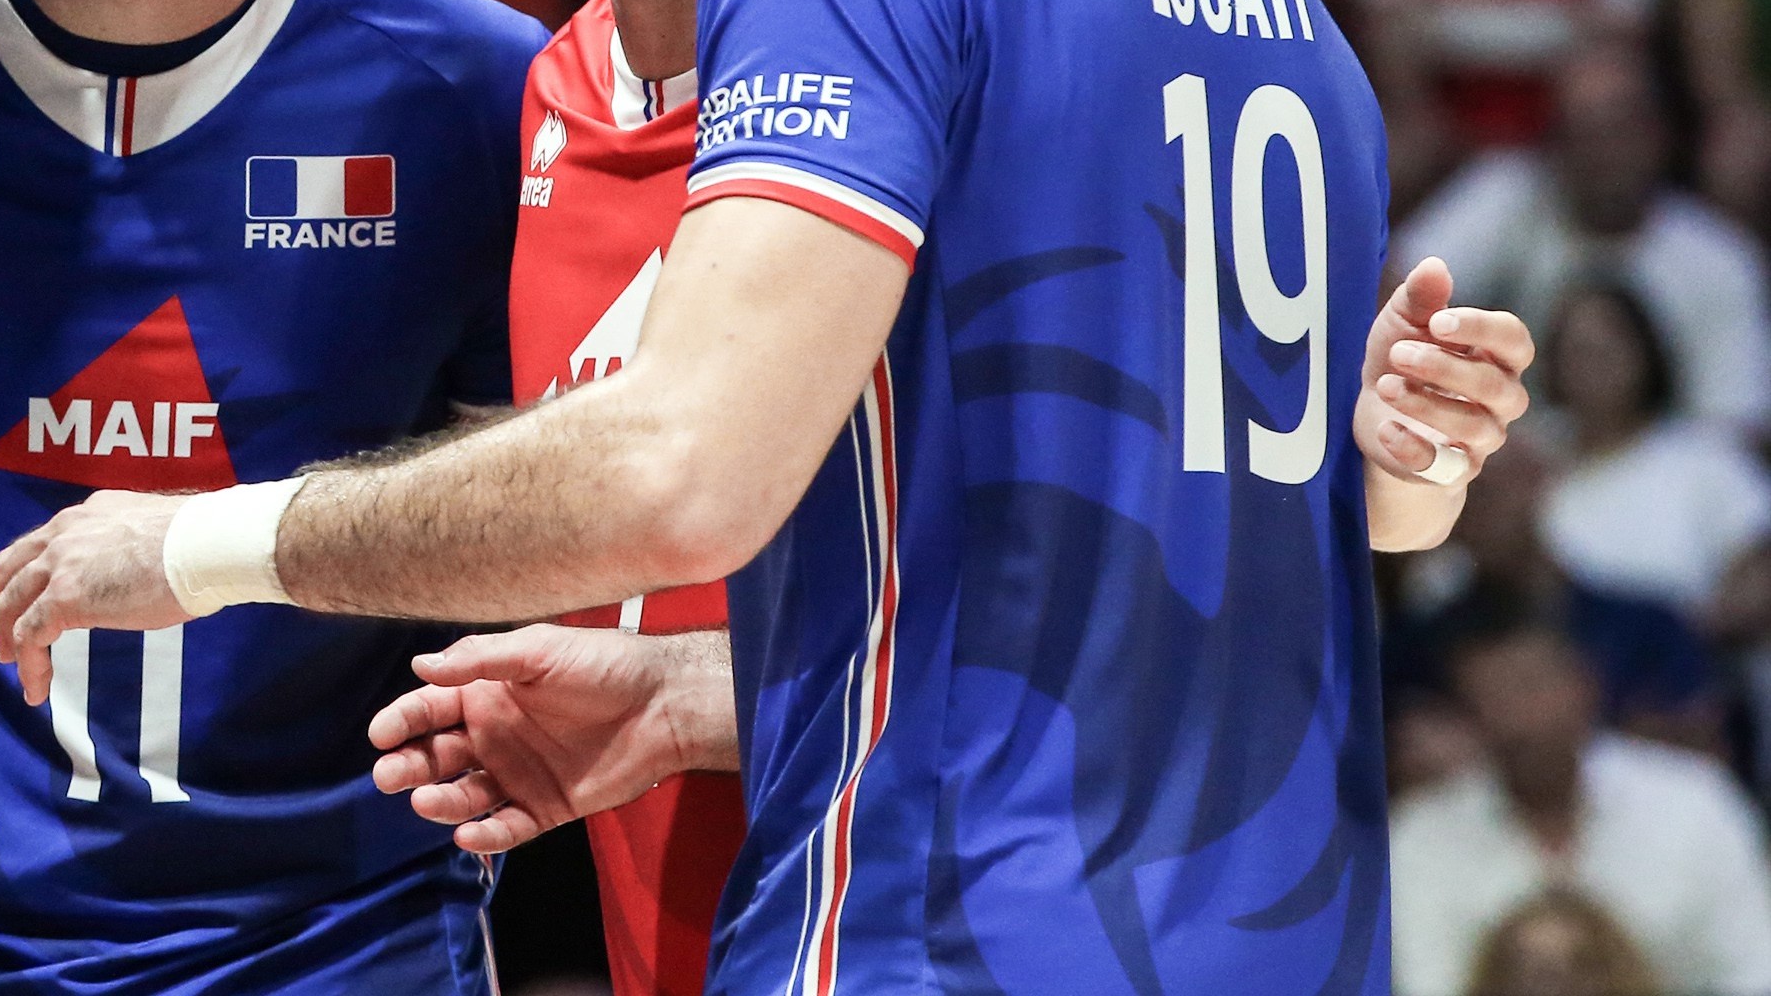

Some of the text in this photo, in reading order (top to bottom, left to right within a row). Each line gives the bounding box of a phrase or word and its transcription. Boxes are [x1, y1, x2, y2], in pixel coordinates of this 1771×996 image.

[244, 220, 397, 249] FRANCE
[1162, 72, 1328, 485] 19
[27, 397, 220, 458] MAIF
[48, 628, 190, 803] 11
